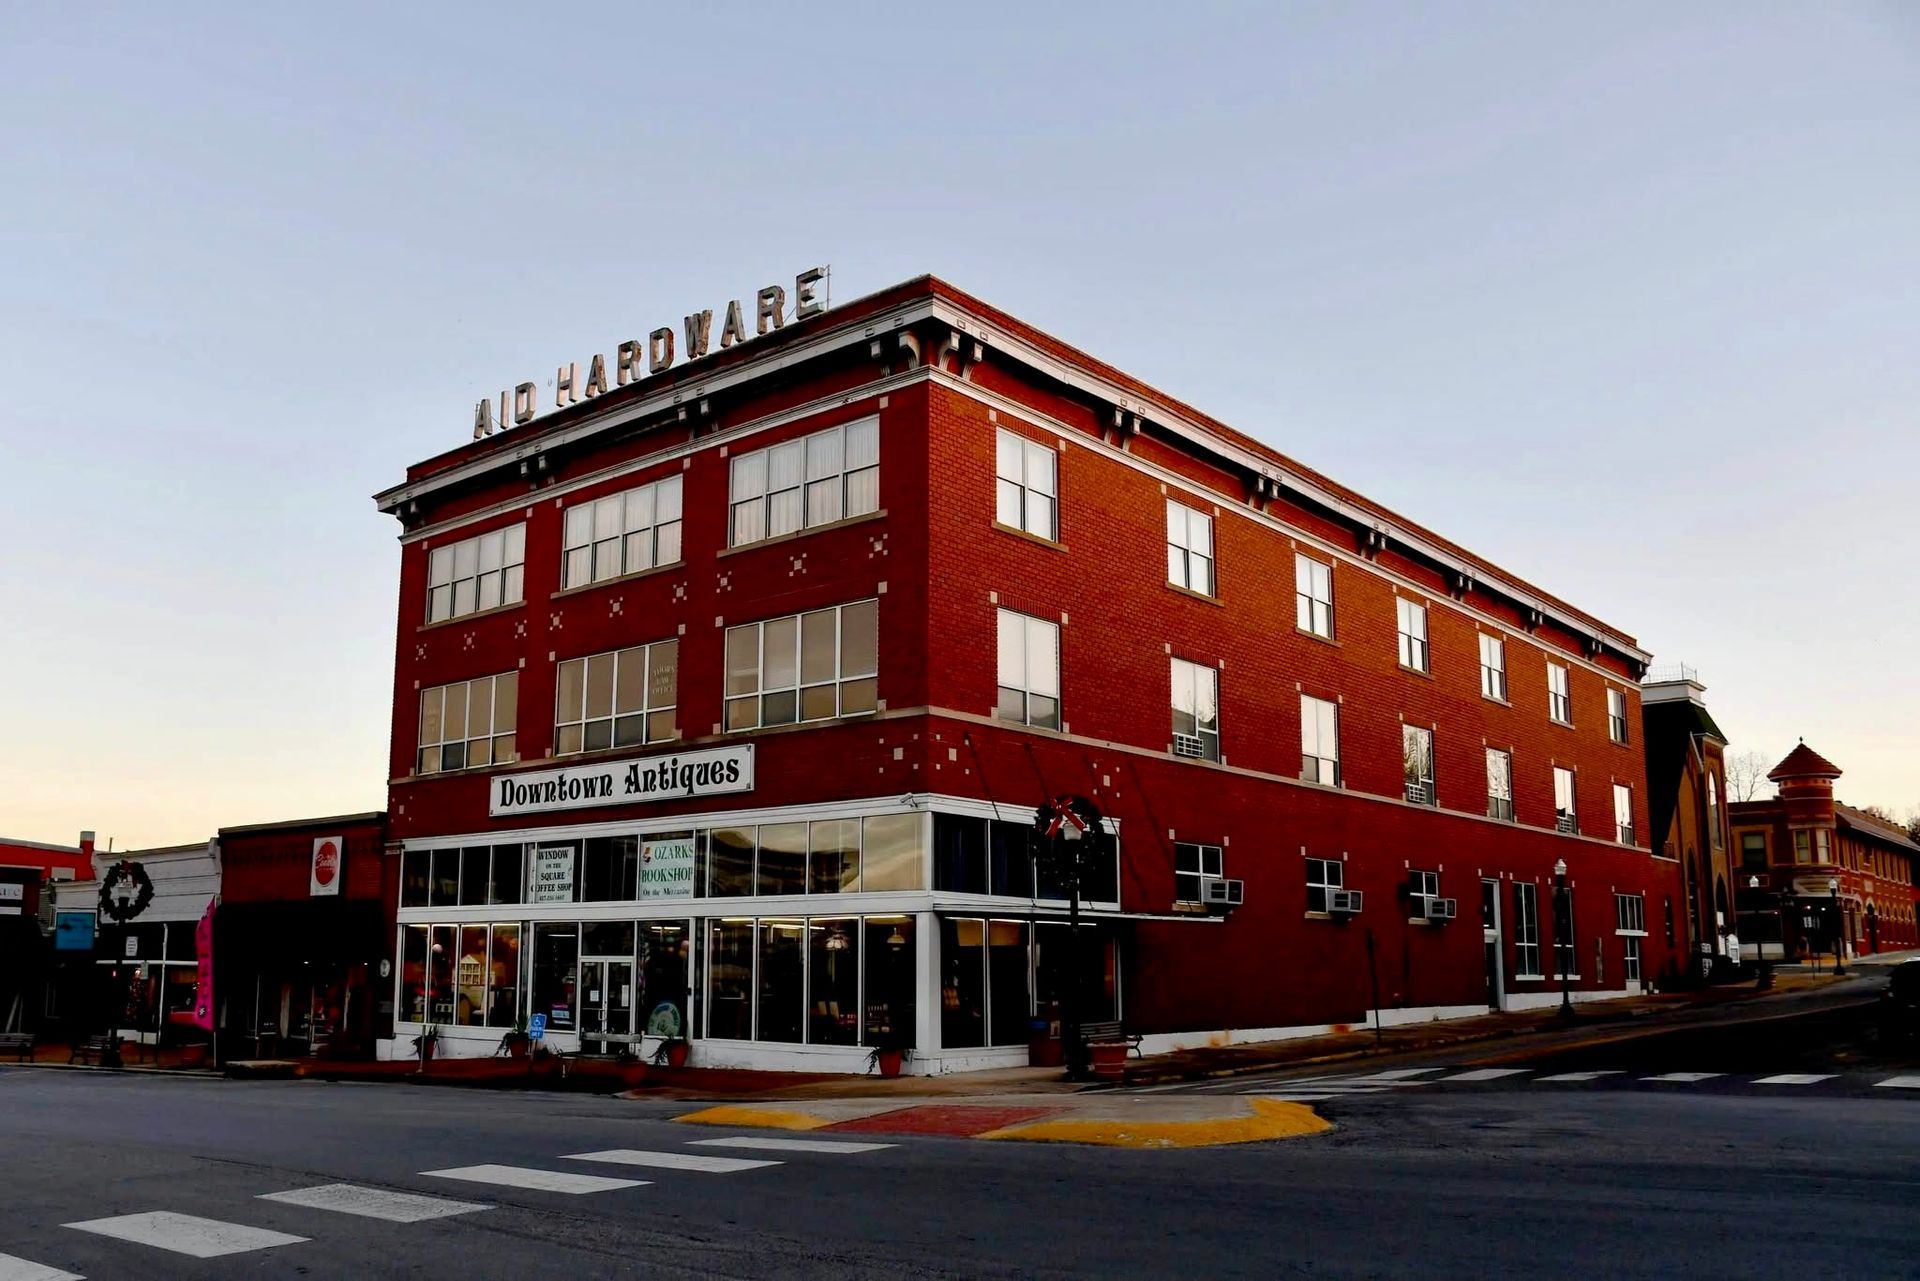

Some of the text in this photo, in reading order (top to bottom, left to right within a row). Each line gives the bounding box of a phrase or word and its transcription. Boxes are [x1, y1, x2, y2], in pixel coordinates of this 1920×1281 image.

[474, 267, 825, 439] AID HARDWARE
[500, 757, 740, 807] Downtown Antiques
[538, 850, 569, 860] WINDOW
[655, 845, 694, 860] OZARKS
[540, 872, 565, 881] SQUARE
[642, 867, 694, 882] BOOKSHOP
[557, 883, 572, 891] SHOP
